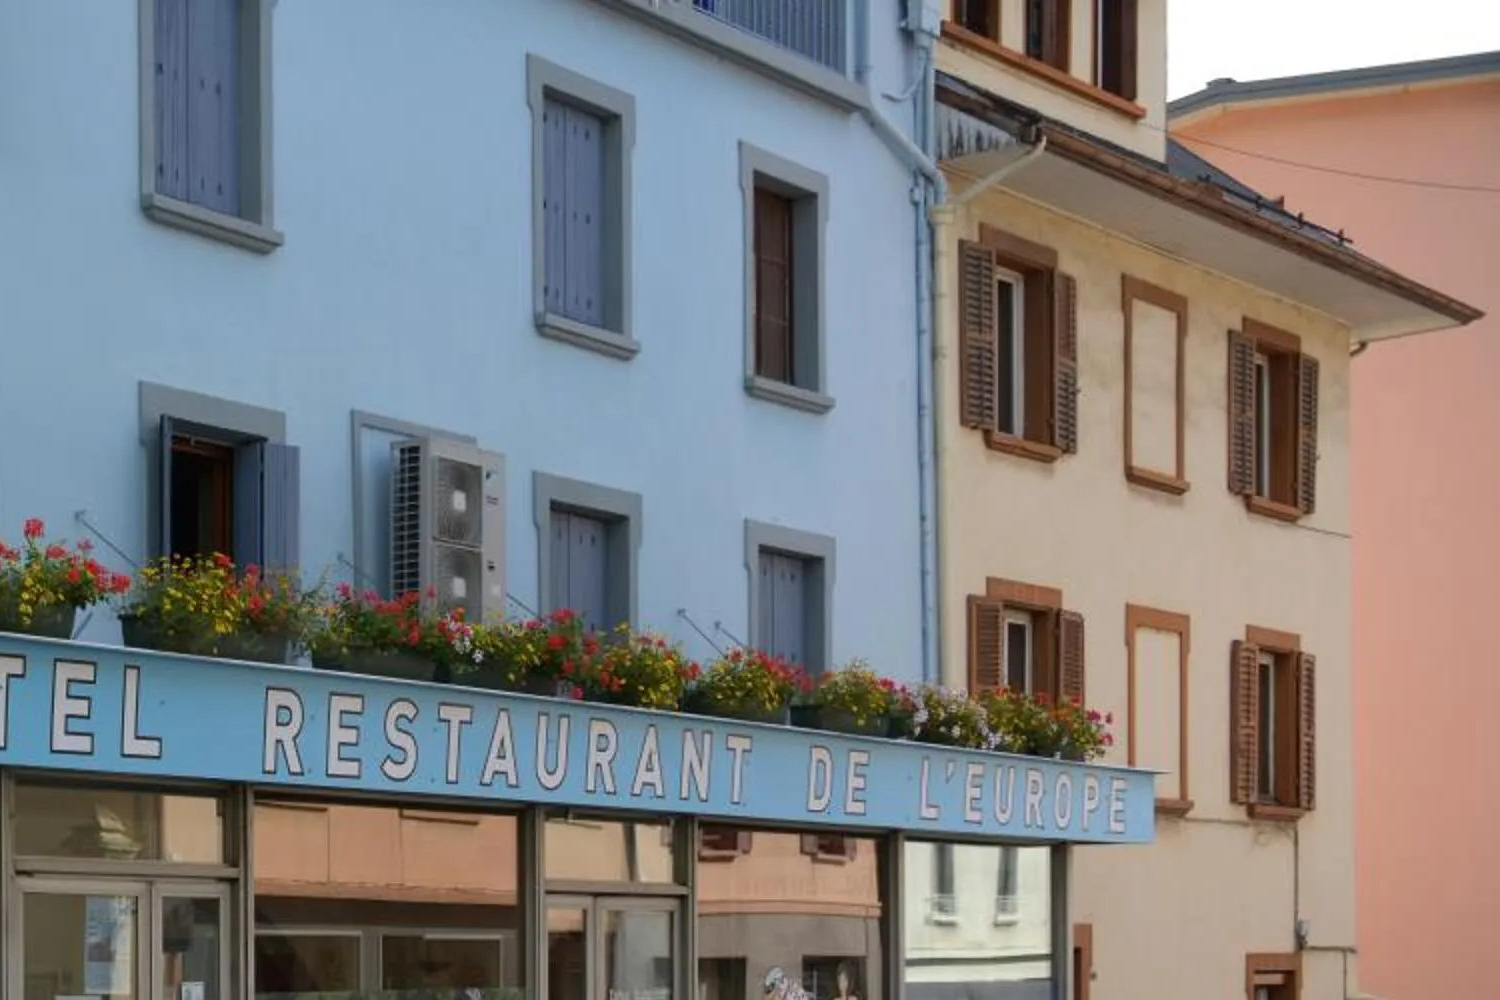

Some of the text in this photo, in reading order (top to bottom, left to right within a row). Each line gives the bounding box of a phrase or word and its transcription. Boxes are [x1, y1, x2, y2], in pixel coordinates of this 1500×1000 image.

[262, 686, 753, 804] RESTAURANT
[807, 746, 870, 816] DE
[919, 755, 1128, 834] L'EUROPE
